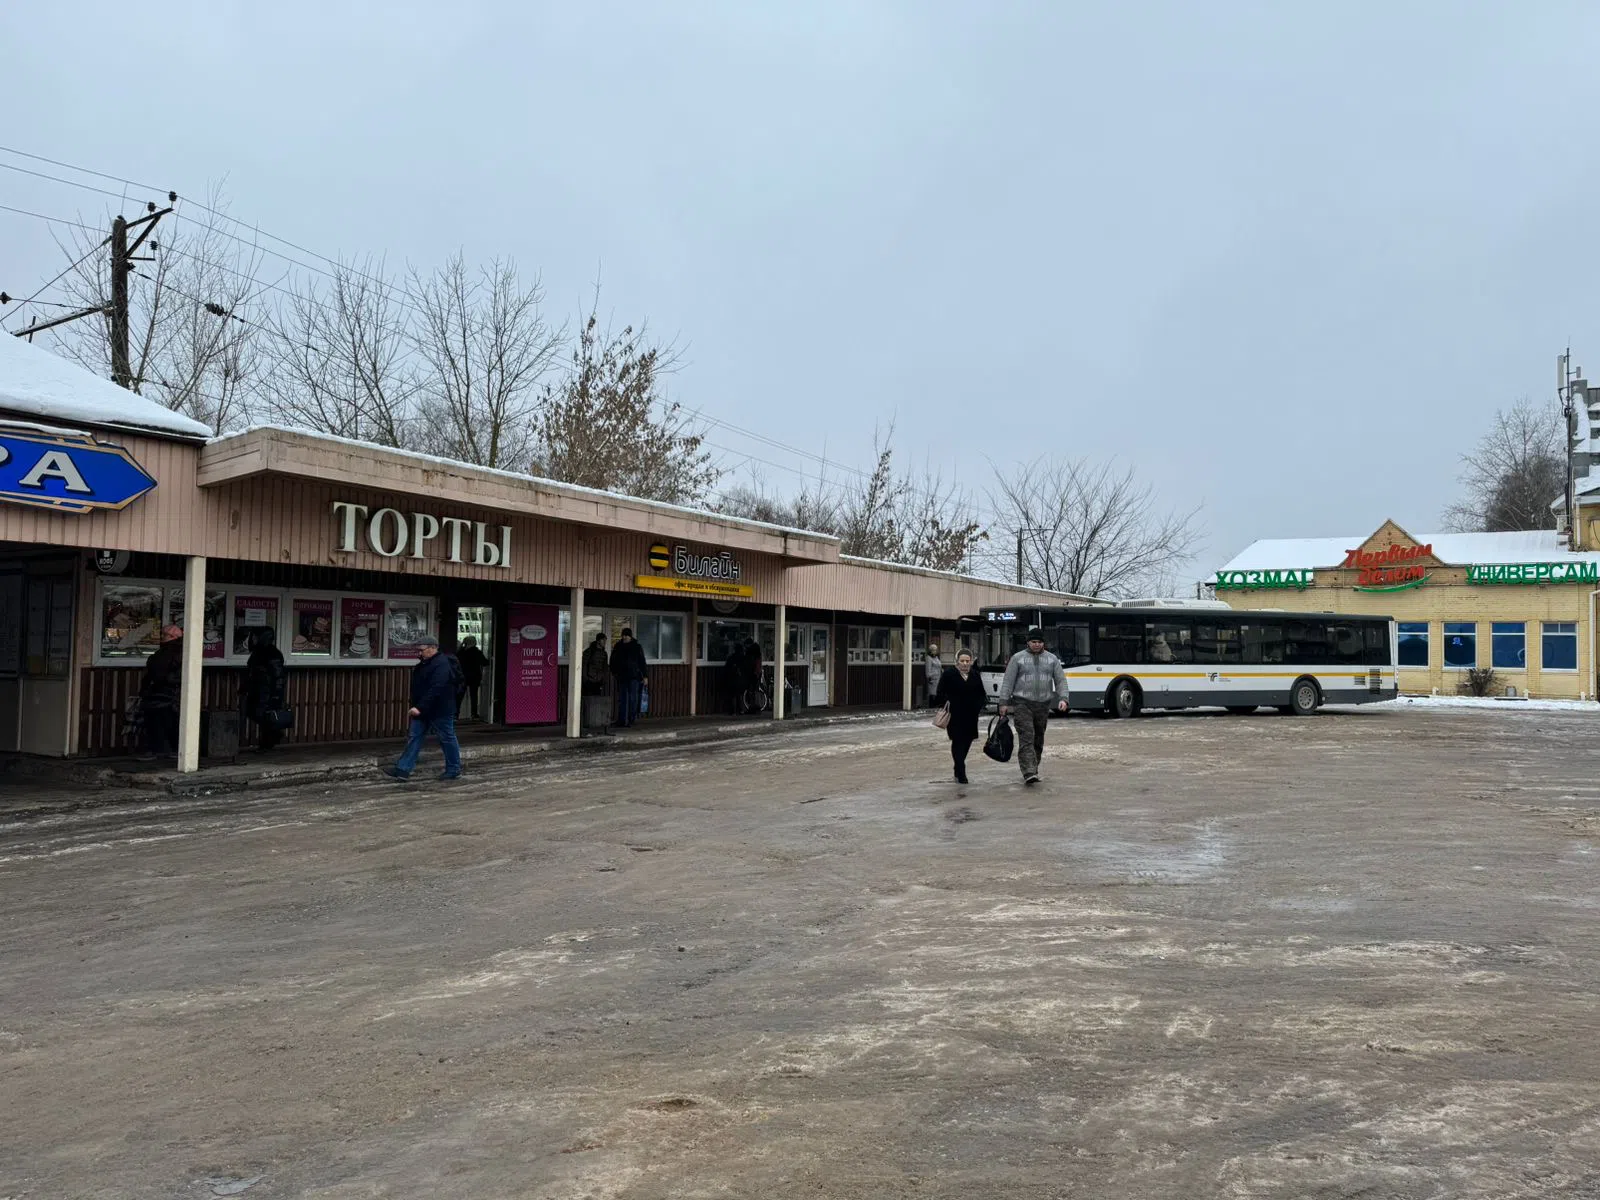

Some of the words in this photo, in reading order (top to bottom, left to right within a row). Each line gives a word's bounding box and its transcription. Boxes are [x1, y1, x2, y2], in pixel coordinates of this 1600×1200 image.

[333, 501, 513, 568] ТОРТЫ
[1215, 568, 1314, 591] ХОЗМАГ
[1465, 561, 1597, 585] УНИВЕРСАМ
[522, 648, 544, 656] ТОРТЫ
